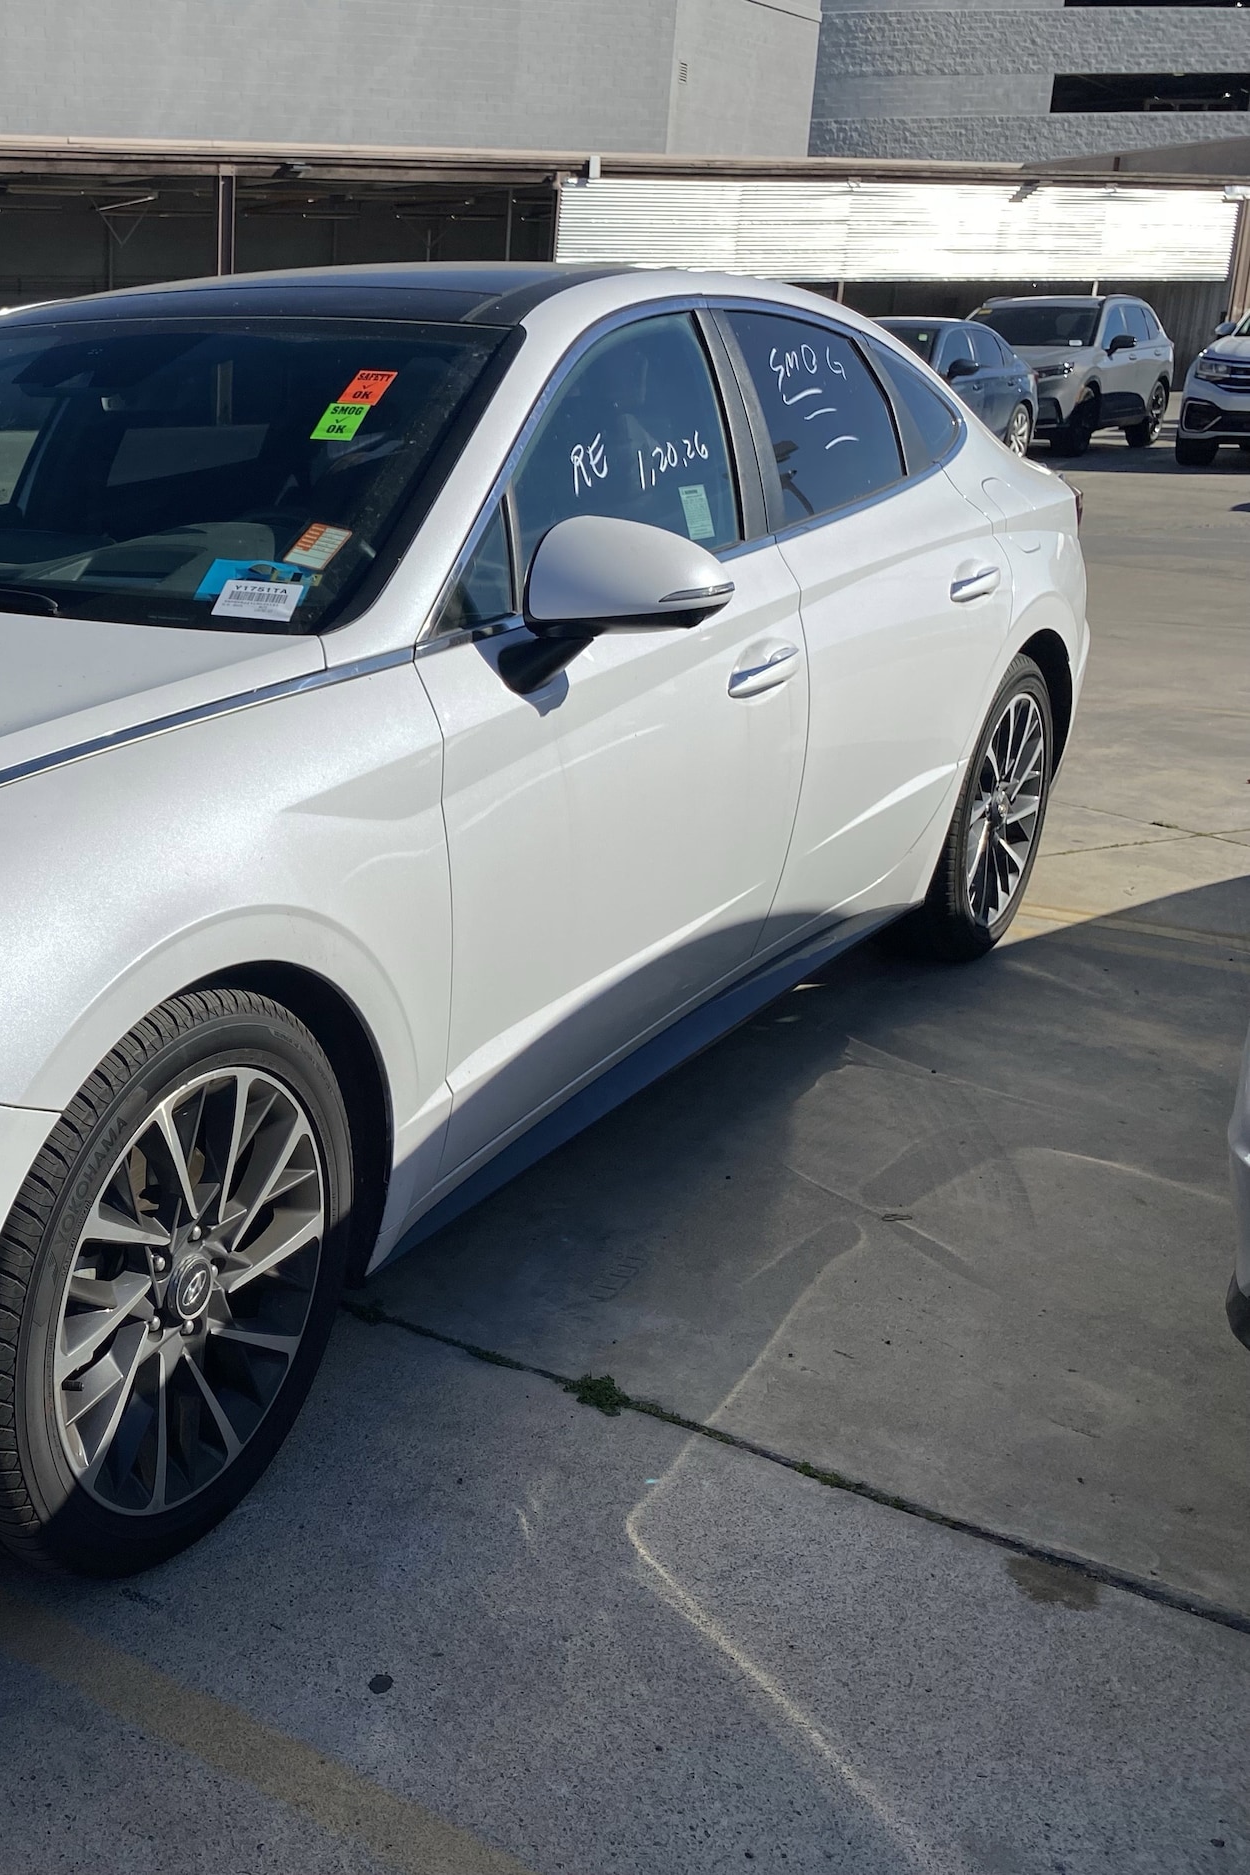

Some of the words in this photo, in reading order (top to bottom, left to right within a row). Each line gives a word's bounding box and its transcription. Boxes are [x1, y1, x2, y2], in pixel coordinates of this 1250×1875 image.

[357, 373, 393, 381] SAFETY
[352, 391, 372, 399] OK
[330, 406, 364, 415] SMOG
[326, 425, 346, 433] OK
[55, 1115, 128, 1244] YOKOHAMA
